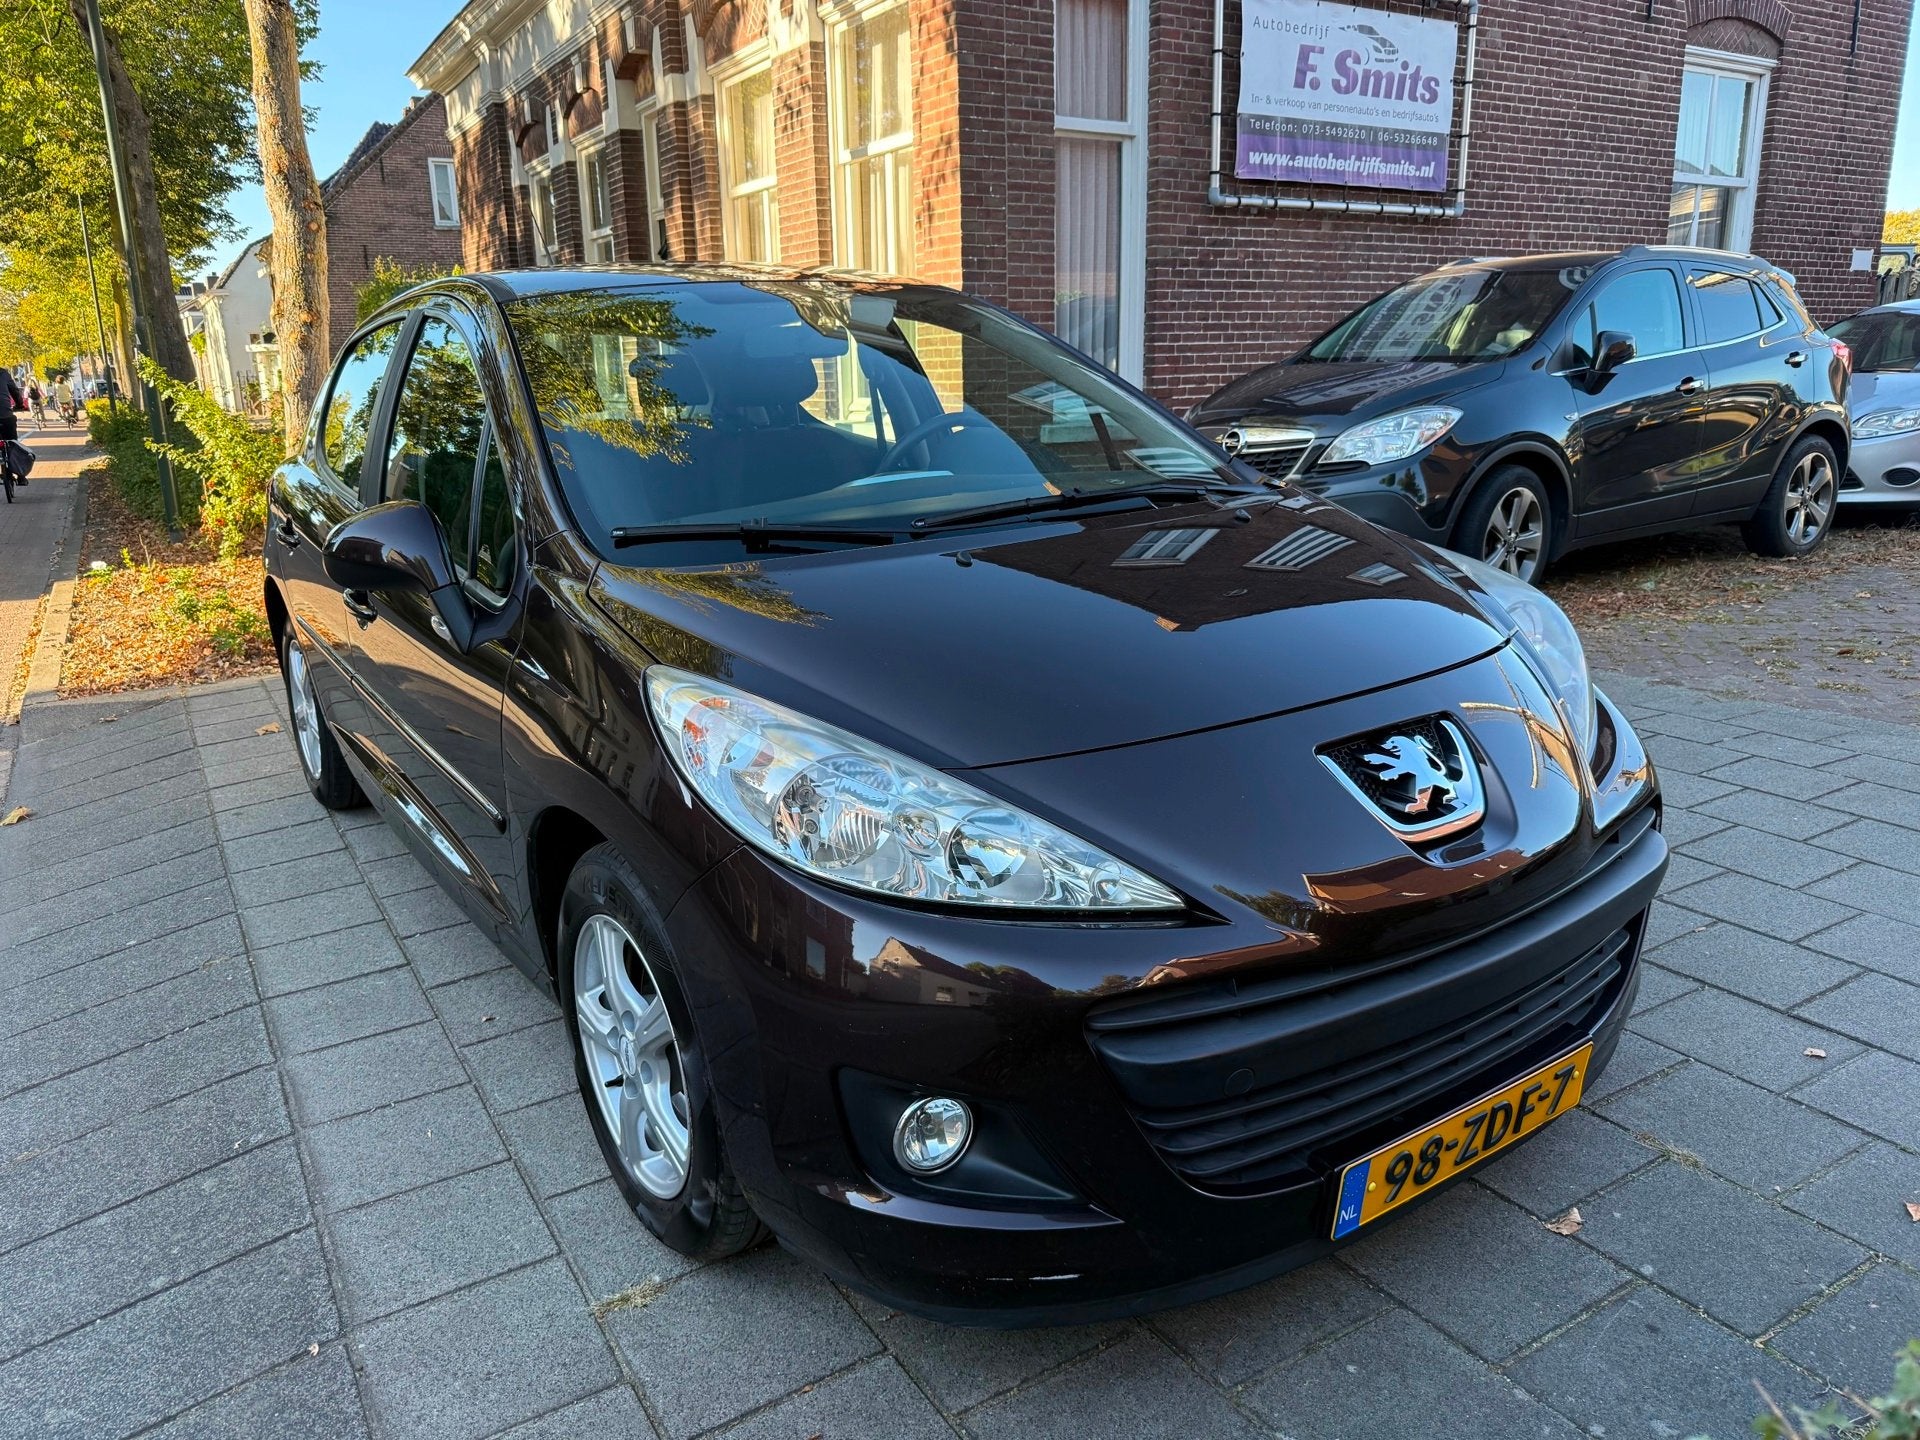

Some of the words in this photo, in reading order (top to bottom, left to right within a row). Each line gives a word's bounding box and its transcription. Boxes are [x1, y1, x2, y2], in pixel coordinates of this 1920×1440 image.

[1253, 16, 1330, 39] Autobedrijf
[1293, 44, 1325, 91] F.
[1331, 49, 1440, 105] Smits
[1265, 95, 1272, 105] &
[1274, 97, 1306, 110] verkoop
[1307, 101, 1322, 110] van
[1381, 109, 1391, 118] en
[1249, 119, 1298, 133] Telefoon:
[1302, 124, 1366, 140] 073-5492620
[1378, 132, 1438, 146] 06-53266648
[1248, 150, 1435, 178] www.autobedrijffsmits.nl
[1384, 1064, 1575, 1203] 98-ZDF-7
[1338, 1204, 1358, 1225] NL
